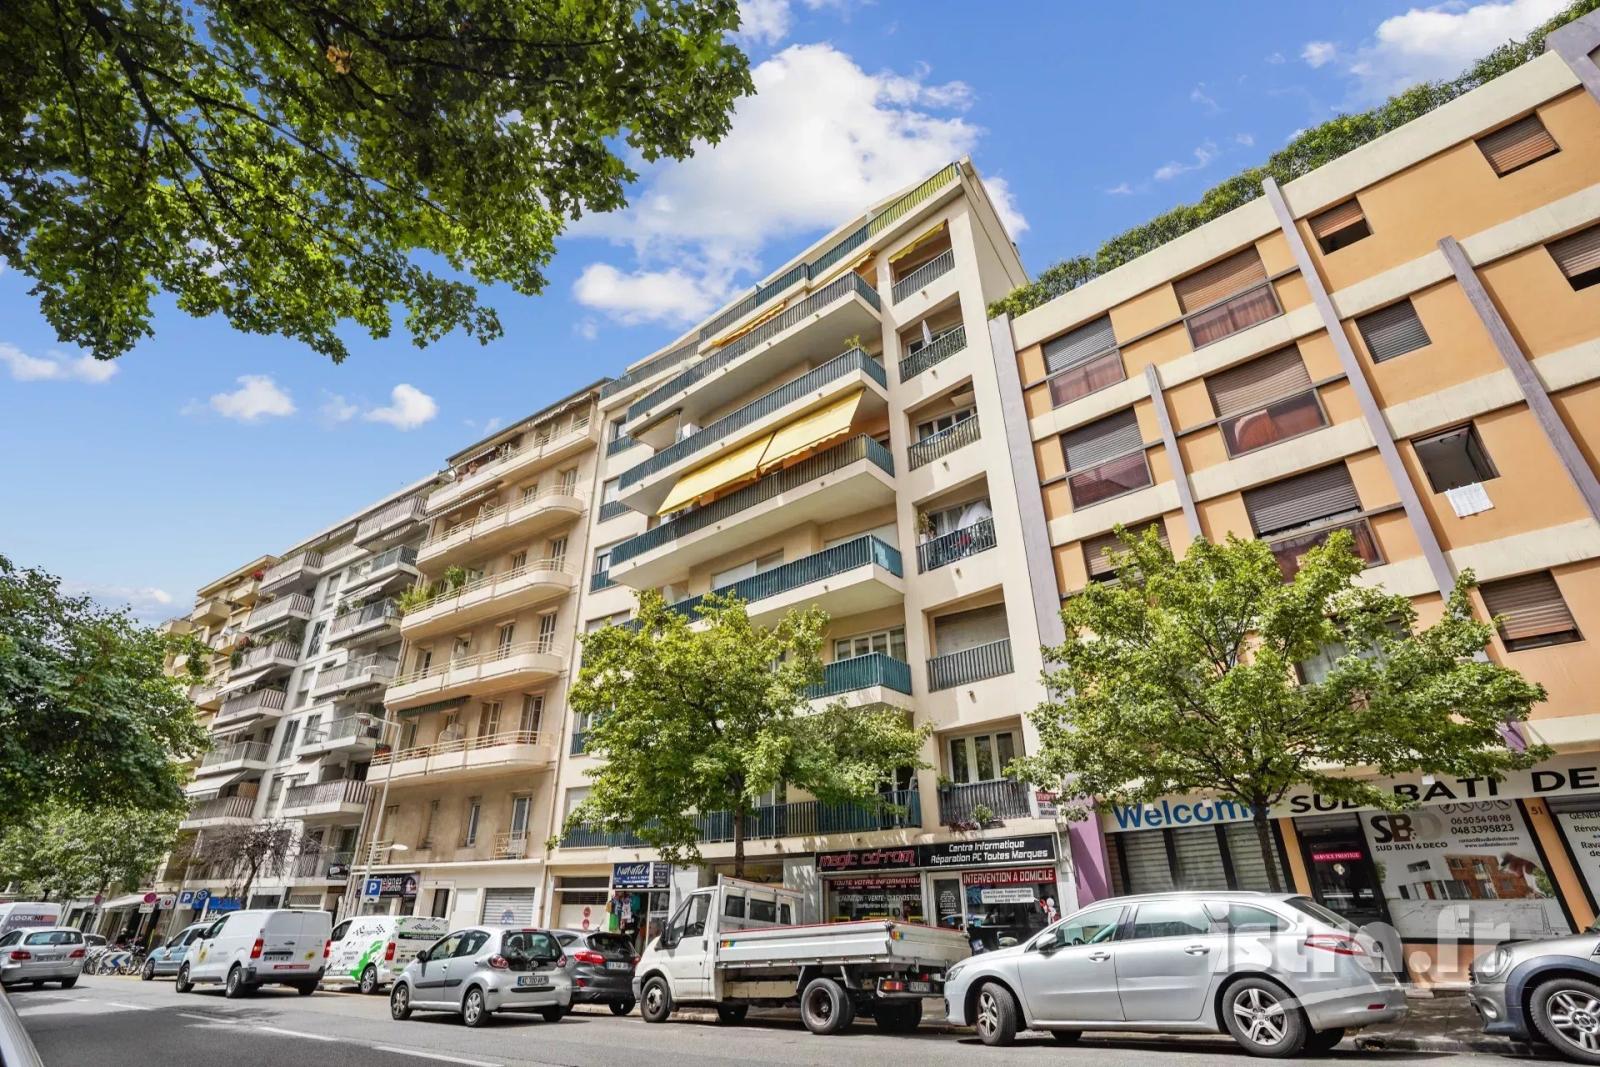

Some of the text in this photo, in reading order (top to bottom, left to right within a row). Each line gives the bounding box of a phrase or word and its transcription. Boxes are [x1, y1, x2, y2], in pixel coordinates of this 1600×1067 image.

[1393, 777, 1498, 801] BATI
[1531, 767, 1600, 792] DE
[1111, 799, 1269, 829] Welcom
[949, 840, 1025, 853] Centre Informatique
[1375, 844, 1392, 852] SUD
[1394, 843, 1414, 851] BATI
[931, 848, 1048, 865] Réparation PC Toutes Marques
[963, 872, 1010, 884] INTERVENTION
[1020, 869, 1054, 881] DOMICILE
[369, 882, 377, 894] P
[183, 893, 190, 902] P
